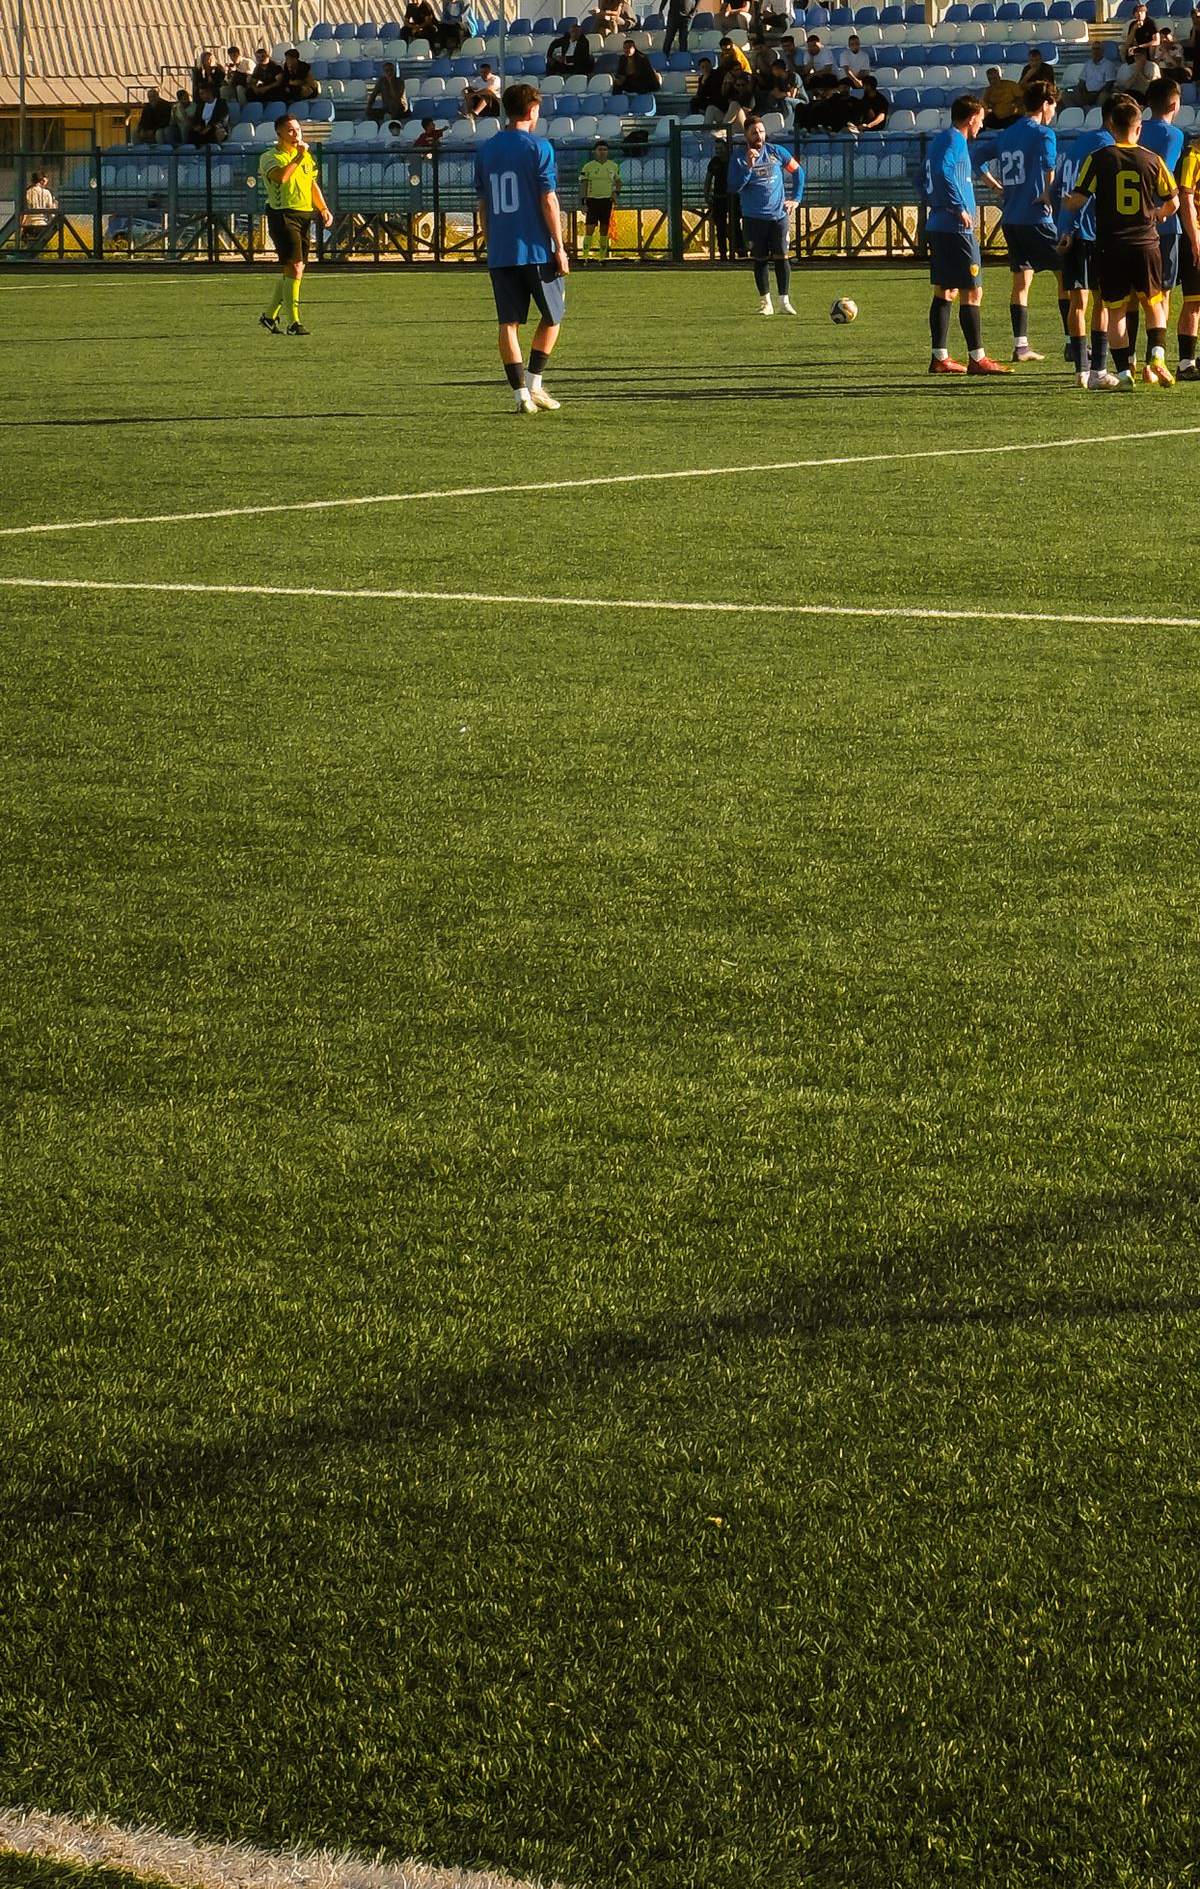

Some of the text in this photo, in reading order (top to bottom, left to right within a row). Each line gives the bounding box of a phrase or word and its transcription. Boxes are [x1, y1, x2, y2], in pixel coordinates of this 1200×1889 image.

[1001, 150, 1026, 186] 23
[489, 171, 520, 215] 10
[1116, 170, 1141, 215] 6
